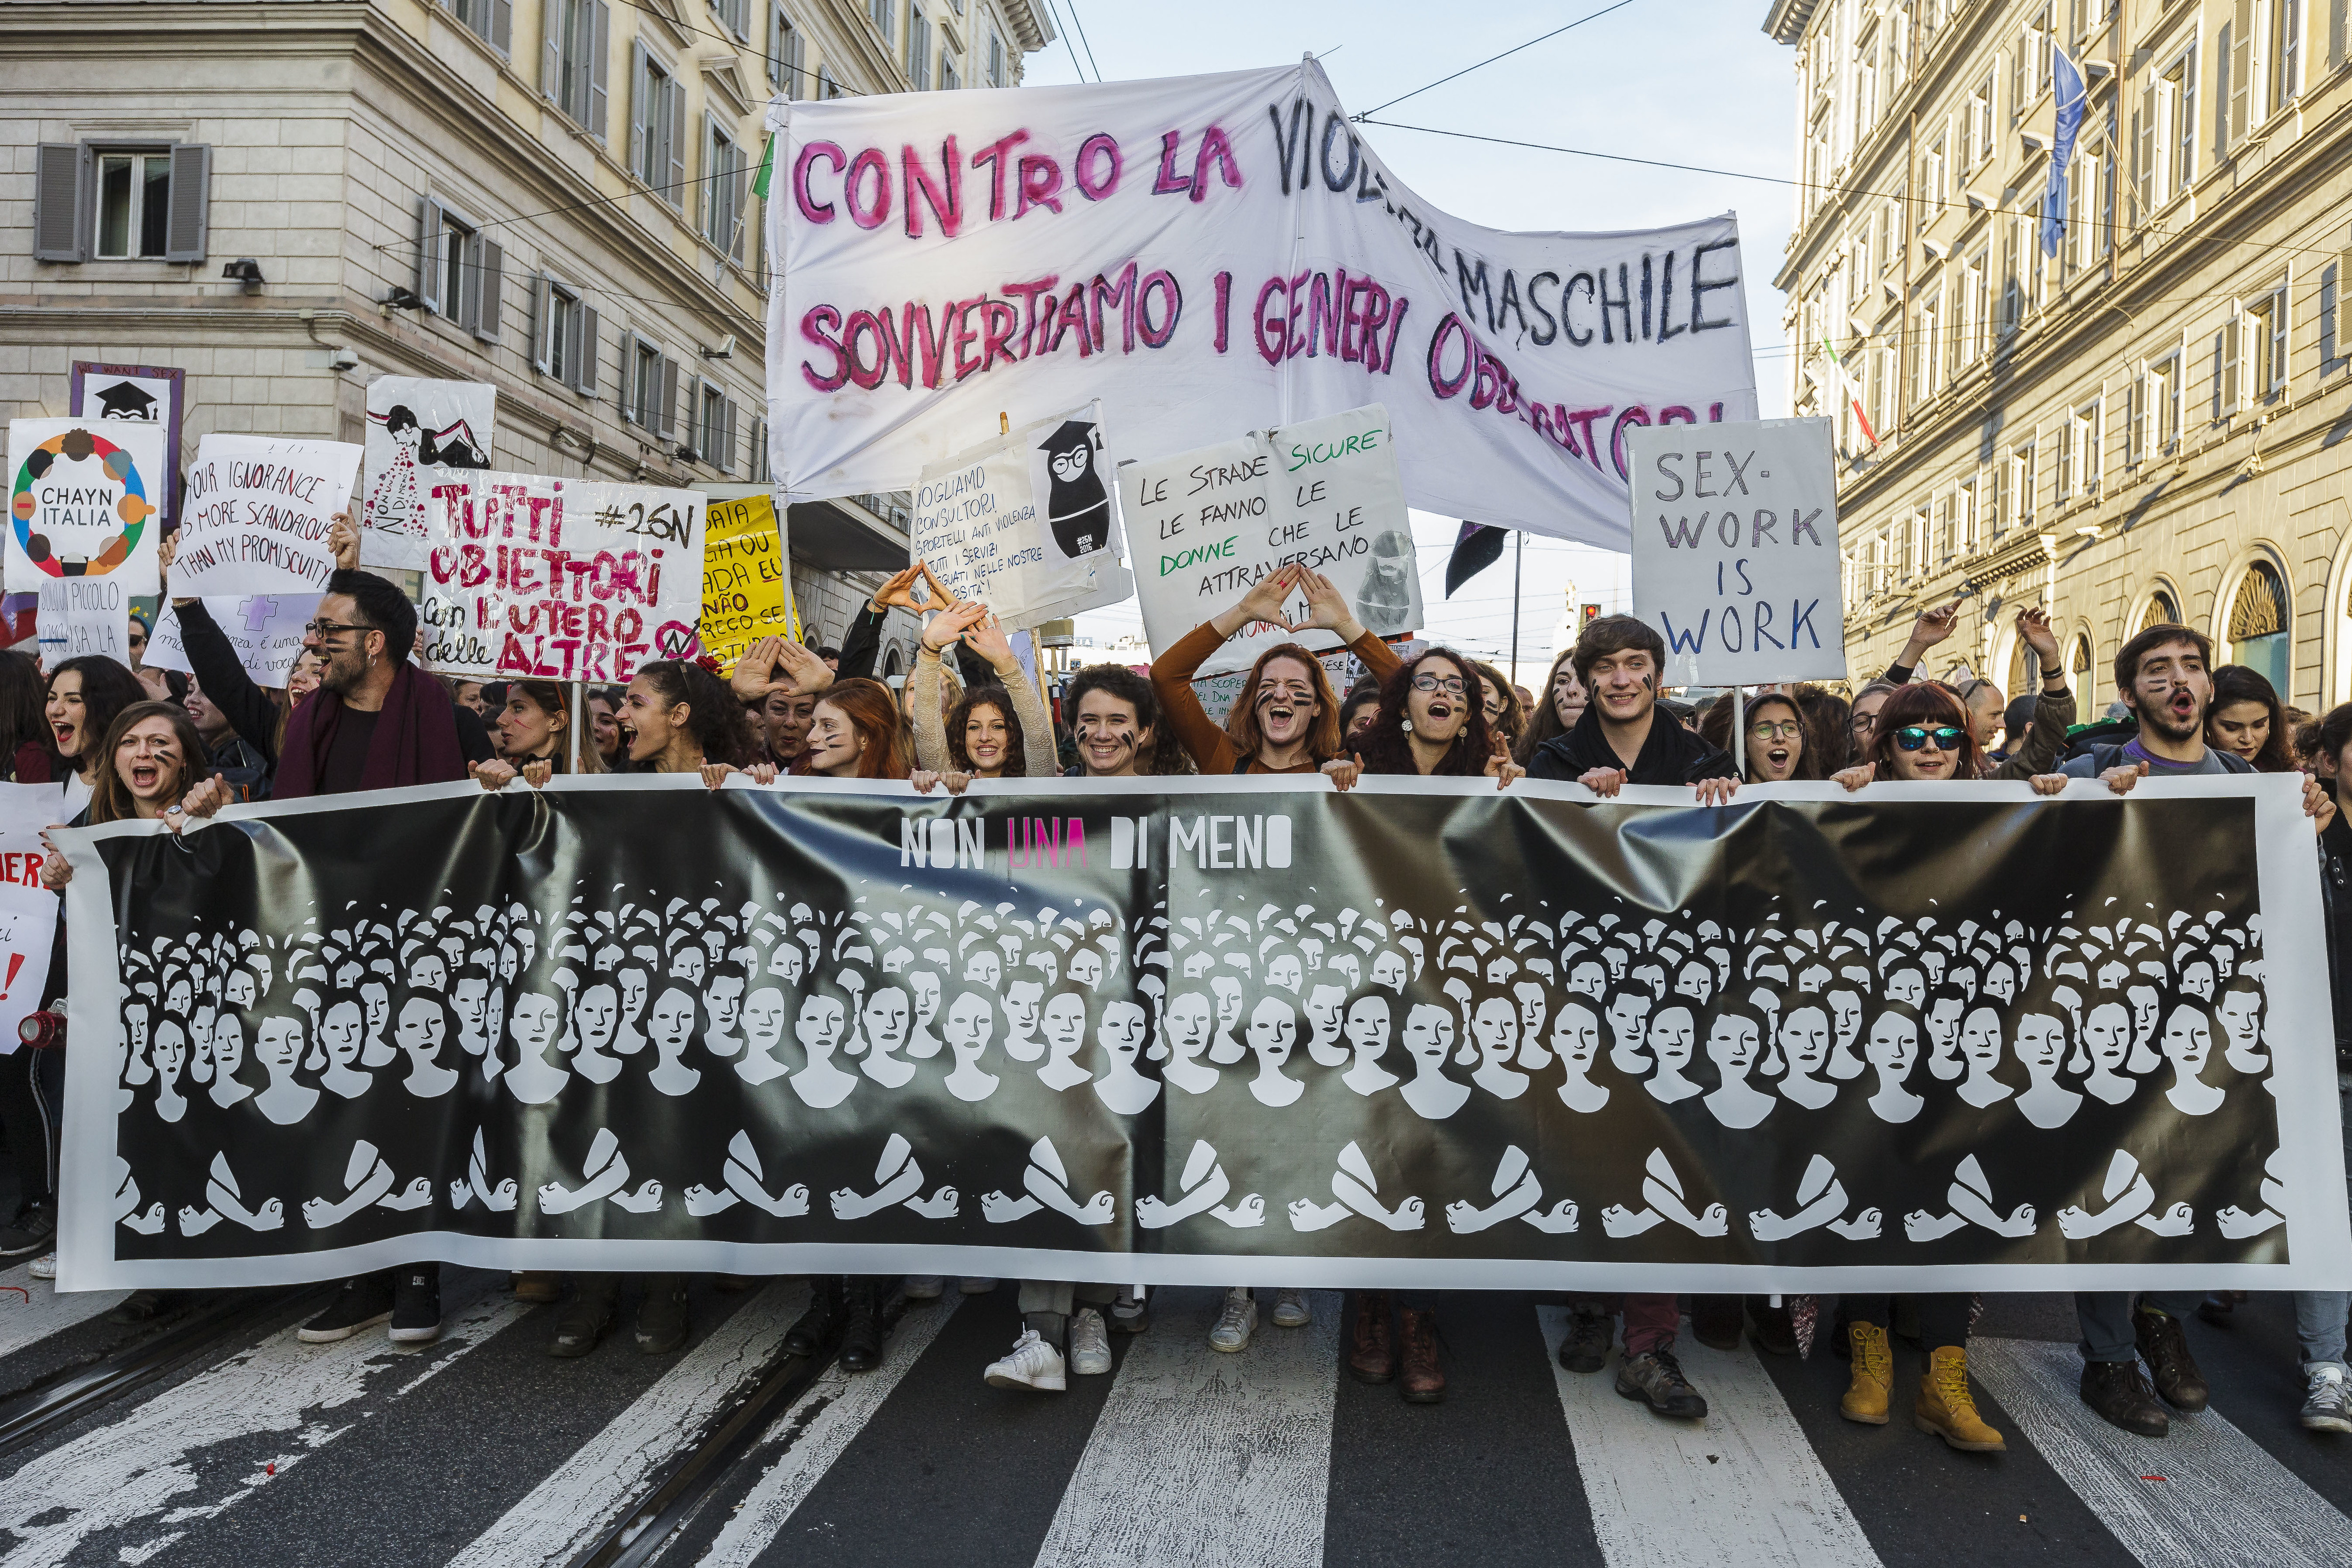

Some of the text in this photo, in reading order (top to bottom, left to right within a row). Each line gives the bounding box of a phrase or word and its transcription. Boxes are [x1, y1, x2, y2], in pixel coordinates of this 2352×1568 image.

[793, 127, 1124, 239] CONTRO
[1151, 125, 1244, 204] LA
[1454, 238, 1738, 348] MASCHILE
[800, 261, 1182, 393] SOVVERTIAMO
[1213, 271, 1233, 355] I
[1253, 267, 1409, 376] GENERI
[76, 362, 179, 380] WE WANT SEX
[188, 461, 326, 505] YOUR IGNORANCE
[917, 466, 985, 508] VOGLIAMO
[1141, 429, 1383, 507] LE STRADE SICURE
[42, 488, 112, 506] CHAYN
[1160, 480, 1327, 540] LE FANNO LE
[43, 508, 111, 527] ITALIA
[181, 516, 193, 541] IS
[198, 499, 239, 532] MORE
[594, 502, 694, 549] #26N
[1659, 508, 1823, 549] WORK
[740, 531, 770, 556] OU
[915, 530, 965, 556] SPORTELLI
[972, 523, 992, 540] ANTI
[928, 555, 948, 573] TUTTI
[962, 542, 998, 565] SERVIZI
[1077, 534, 1093, 546] #26N
[1080, 543, 1093, 554] 2016
[1160, 507, 1364, 577] DONNE CHE LE
[175, 534, 332, 589] THAN MY PROMISCUITY
[974, 559, 1003, 579] NELLE
[1008, 547, 1043, 569] NOSTRE
[1717, 558, 1753, 596] IS
[72, 581, 119, 611] PICCOLO
[701, 591, 749, 618] NÃO
[96, 624, 117, 653] LA
[272, 636, 304, 649] una
[1661, 599, 1821, 654] WORK
[243, 652, 261, 670] di
[426, 630, 650, 682] delle ALTRE
[901, 815, 1292, 869] NON UNA DI MENO
